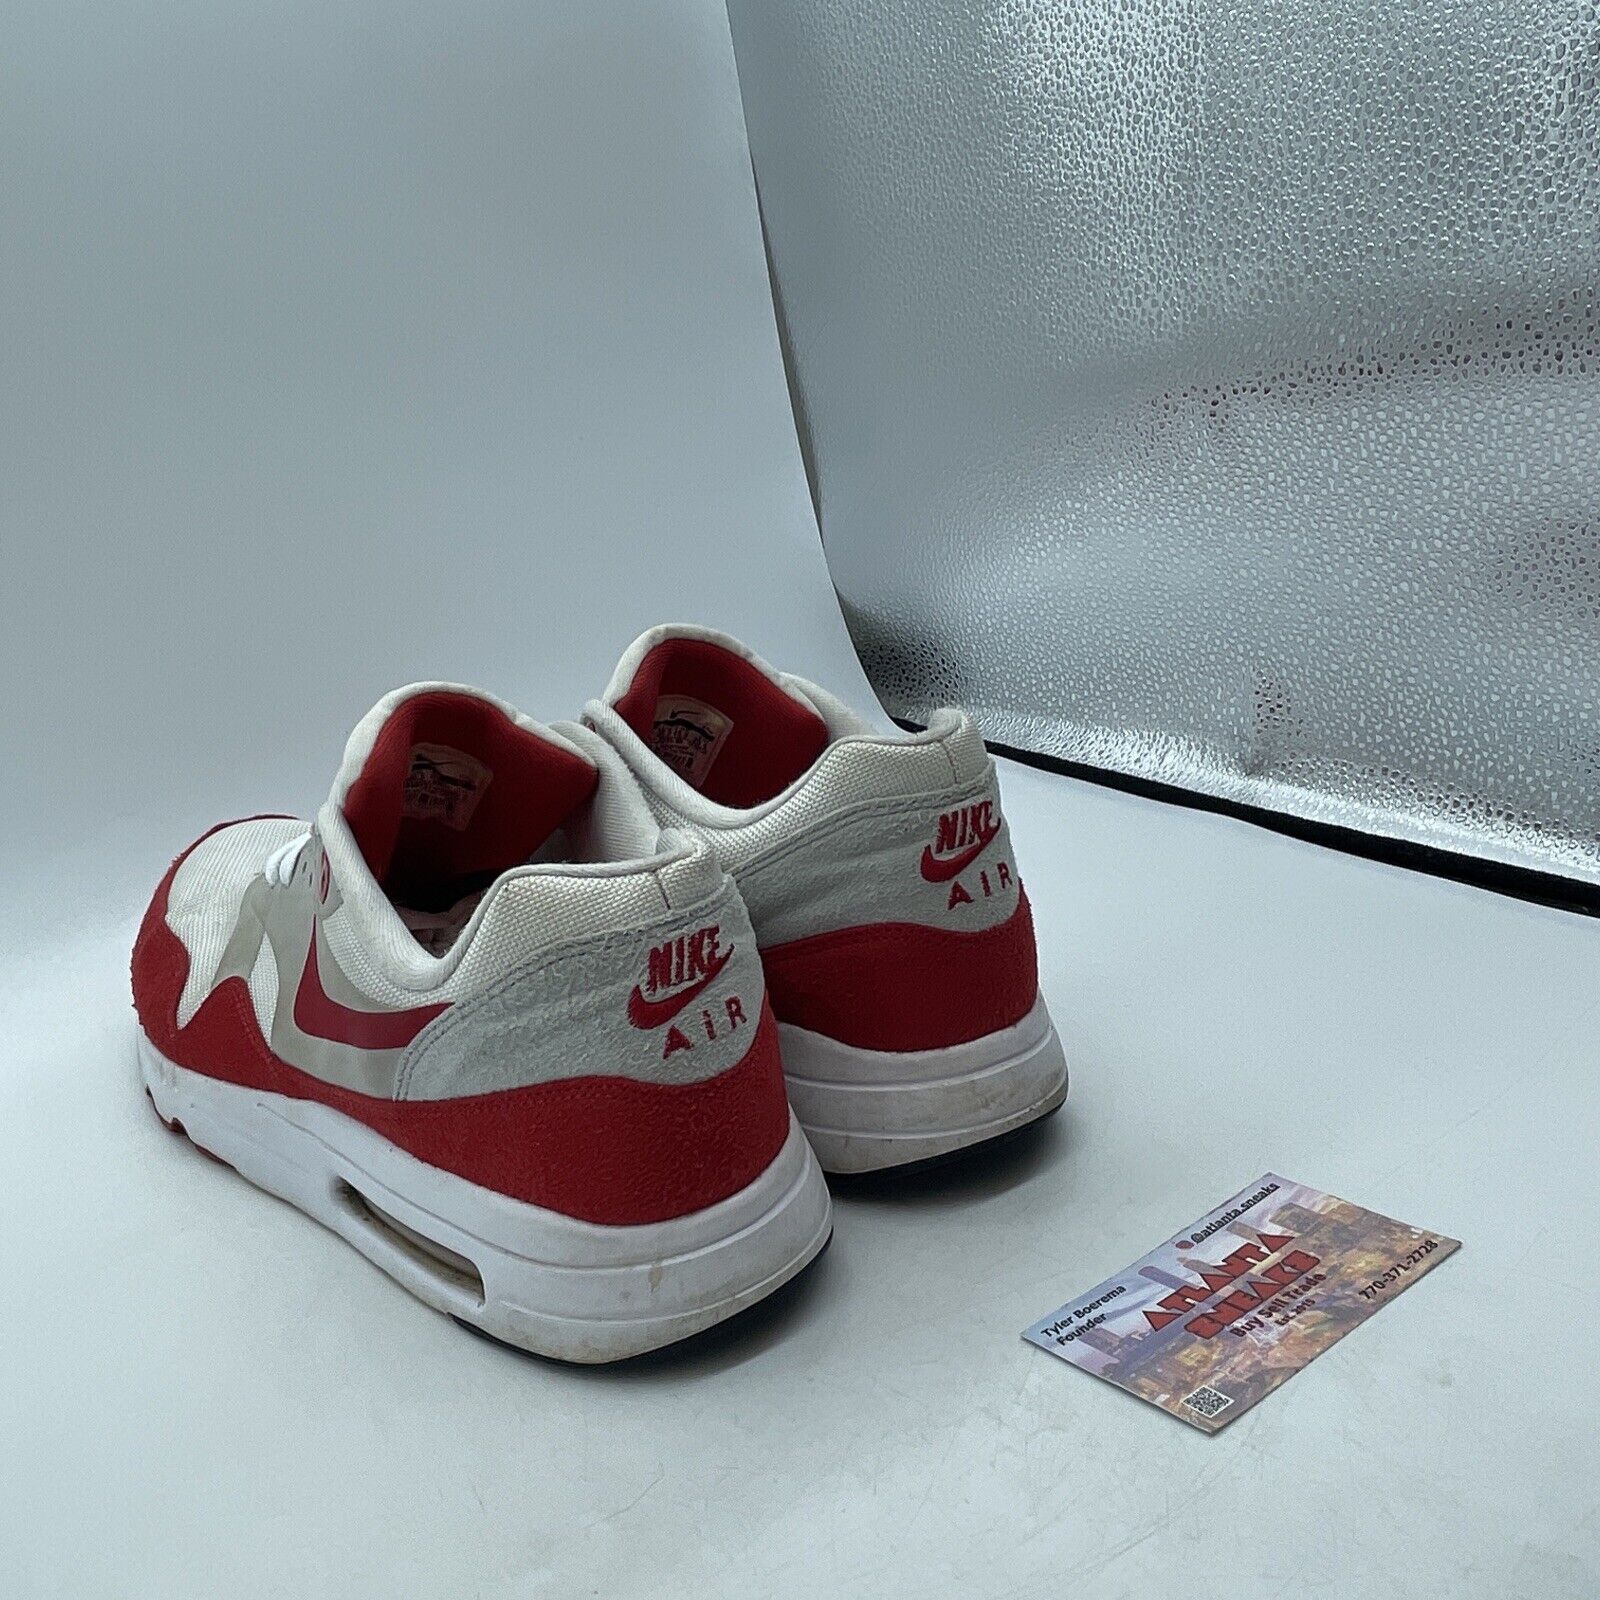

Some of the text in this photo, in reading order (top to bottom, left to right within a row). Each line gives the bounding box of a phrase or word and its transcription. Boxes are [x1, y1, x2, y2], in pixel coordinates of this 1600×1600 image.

[935, 800, 993, 854] NIKE
[947, 862, 1012, 910] AIR
[645, 923, 720, 995] NIKE
[662, 995, 747, 1060] AIR
[1191, 1183, 1280, 1243] @atlanta.sneaks
[1143, 1234, 1295, 1332] ATLANTA
[1184, 1250, 1320, 1339] SNEAKS
[1358, 1240, 1438, 1299] 770-371-2728
[1041, 1284, 1127, 1338] Tyler Boerema
[1056, 1312, 1107, 1346] Founder
[1230, 1273, 1326, 1337] Buy Sell Trade
